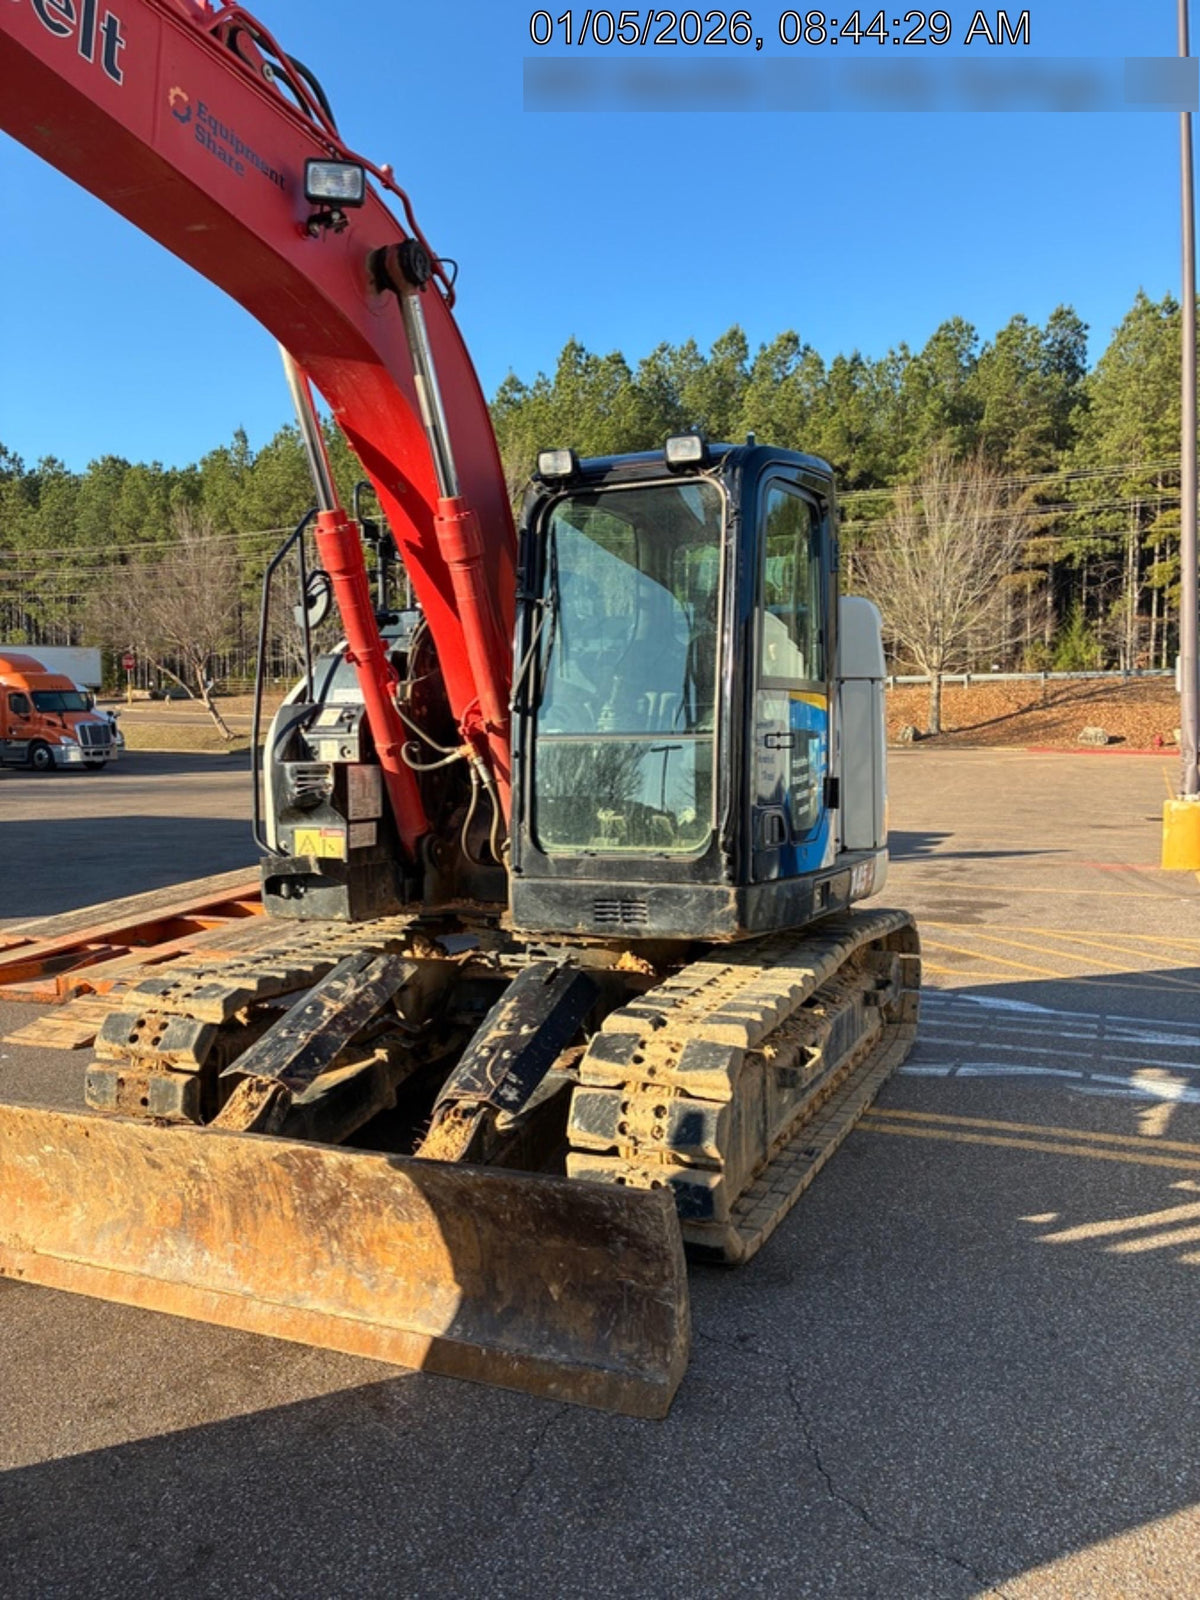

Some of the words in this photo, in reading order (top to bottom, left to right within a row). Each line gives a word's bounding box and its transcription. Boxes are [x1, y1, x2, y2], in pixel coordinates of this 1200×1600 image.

[11, 0, 126, 86] elt
[195, 123, 244, 177] Share
[197, 101, 285, 190] Equipment
